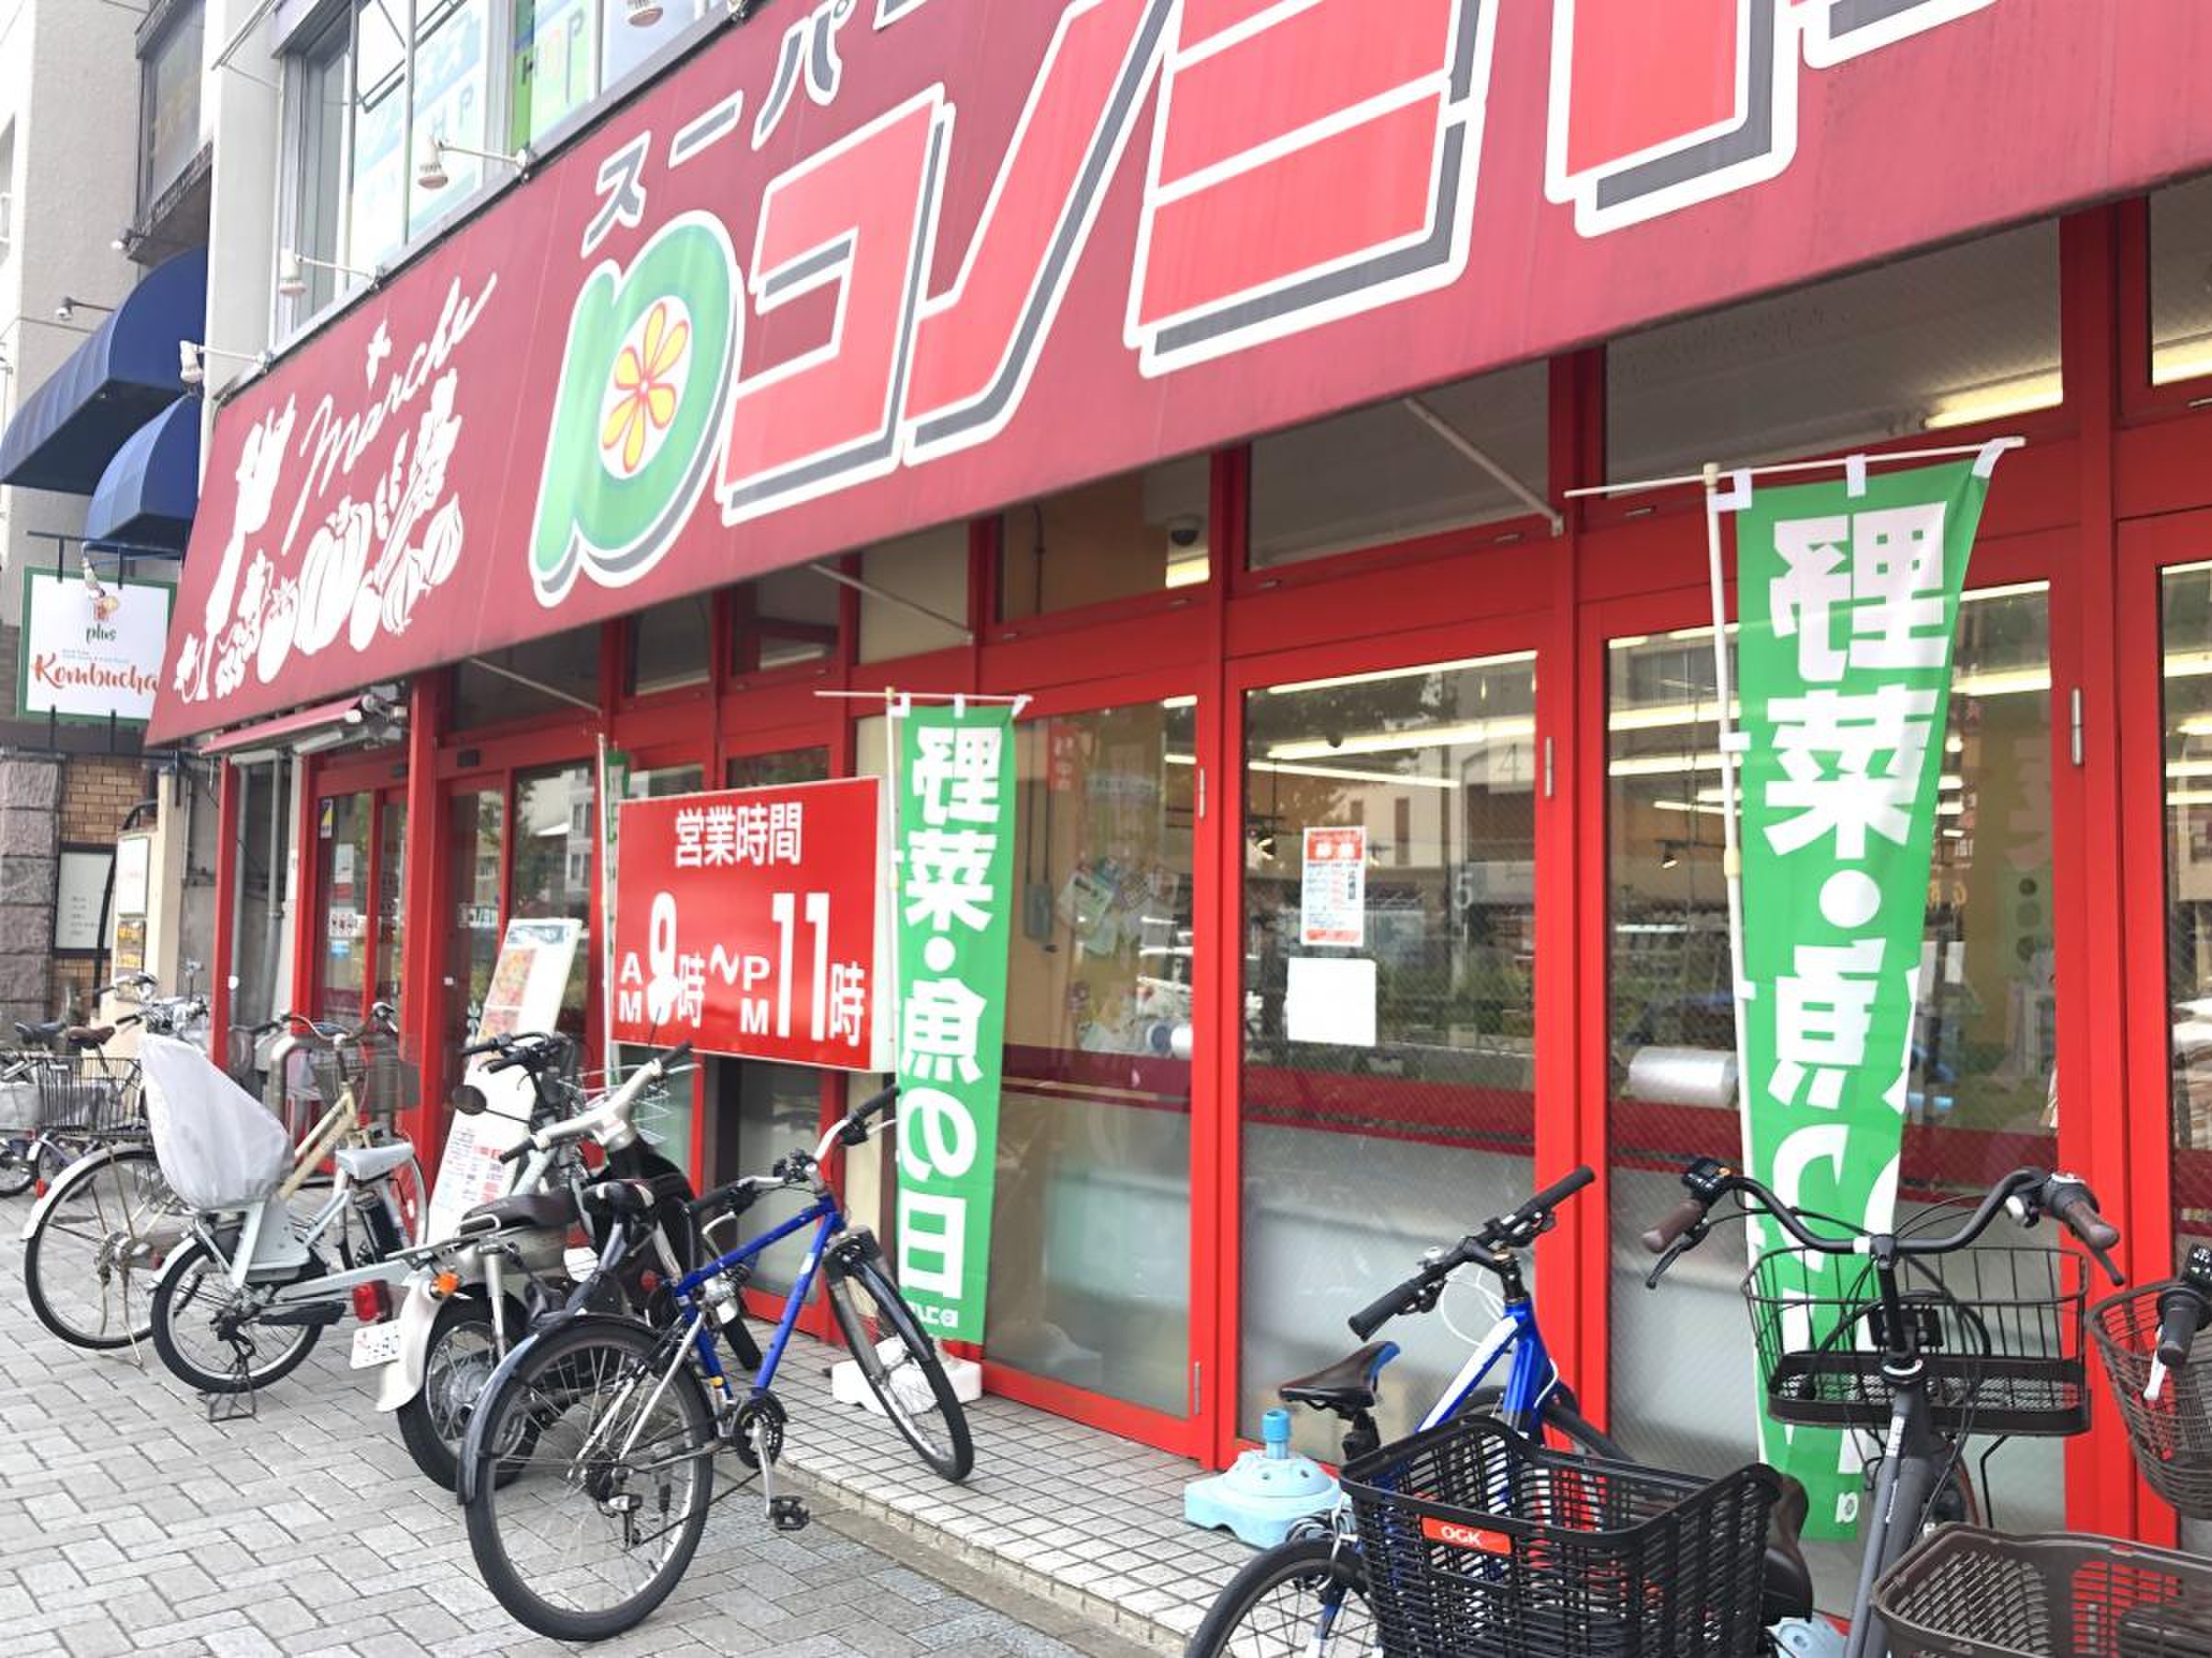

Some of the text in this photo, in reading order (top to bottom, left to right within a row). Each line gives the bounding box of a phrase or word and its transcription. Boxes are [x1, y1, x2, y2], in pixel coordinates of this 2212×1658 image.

[86, 623, 117, 644] plus
[674, 801, 803, 869] 営業時間
[1440, 1525, 1482, 1547] OGK
